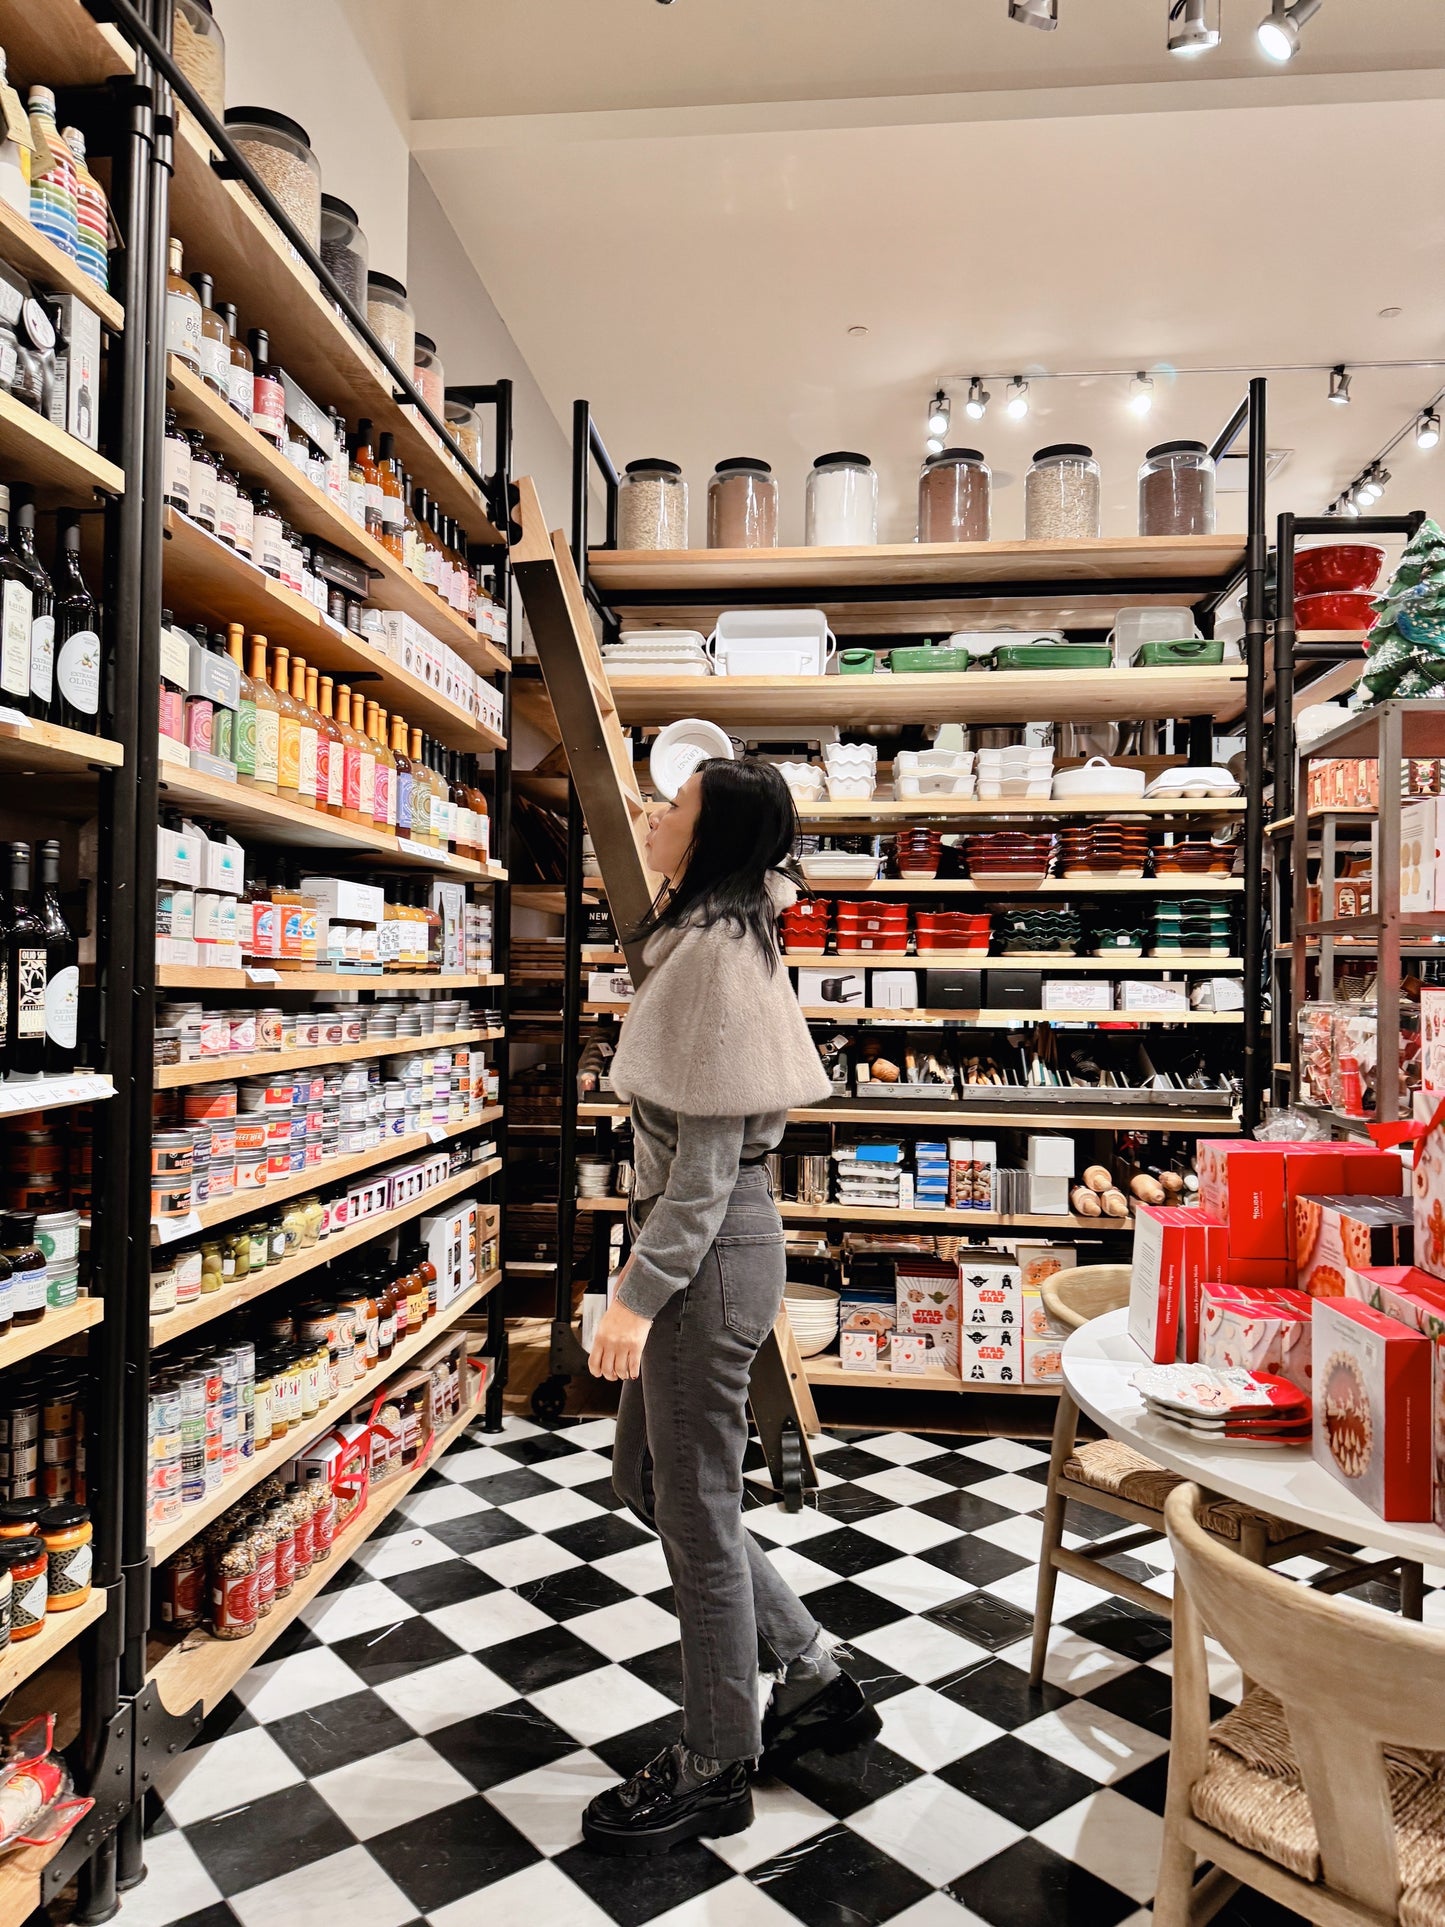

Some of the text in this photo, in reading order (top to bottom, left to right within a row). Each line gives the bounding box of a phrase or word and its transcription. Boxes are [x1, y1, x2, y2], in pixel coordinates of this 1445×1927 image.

[589, 912, 609, 921] NEW
[1252, 1191, 1261, 1220] HOLIDAY
[978, 1289, 1006, 1297] STAR
[978, 1295, 1006, 1303] WARS
[912, 1309, 943, 1318] STAR
[912, 1316, 943, 1325] WARS
[977, 1346, 1005, 1354] STAR
[977, 1352, 1005, 1360] WARS
